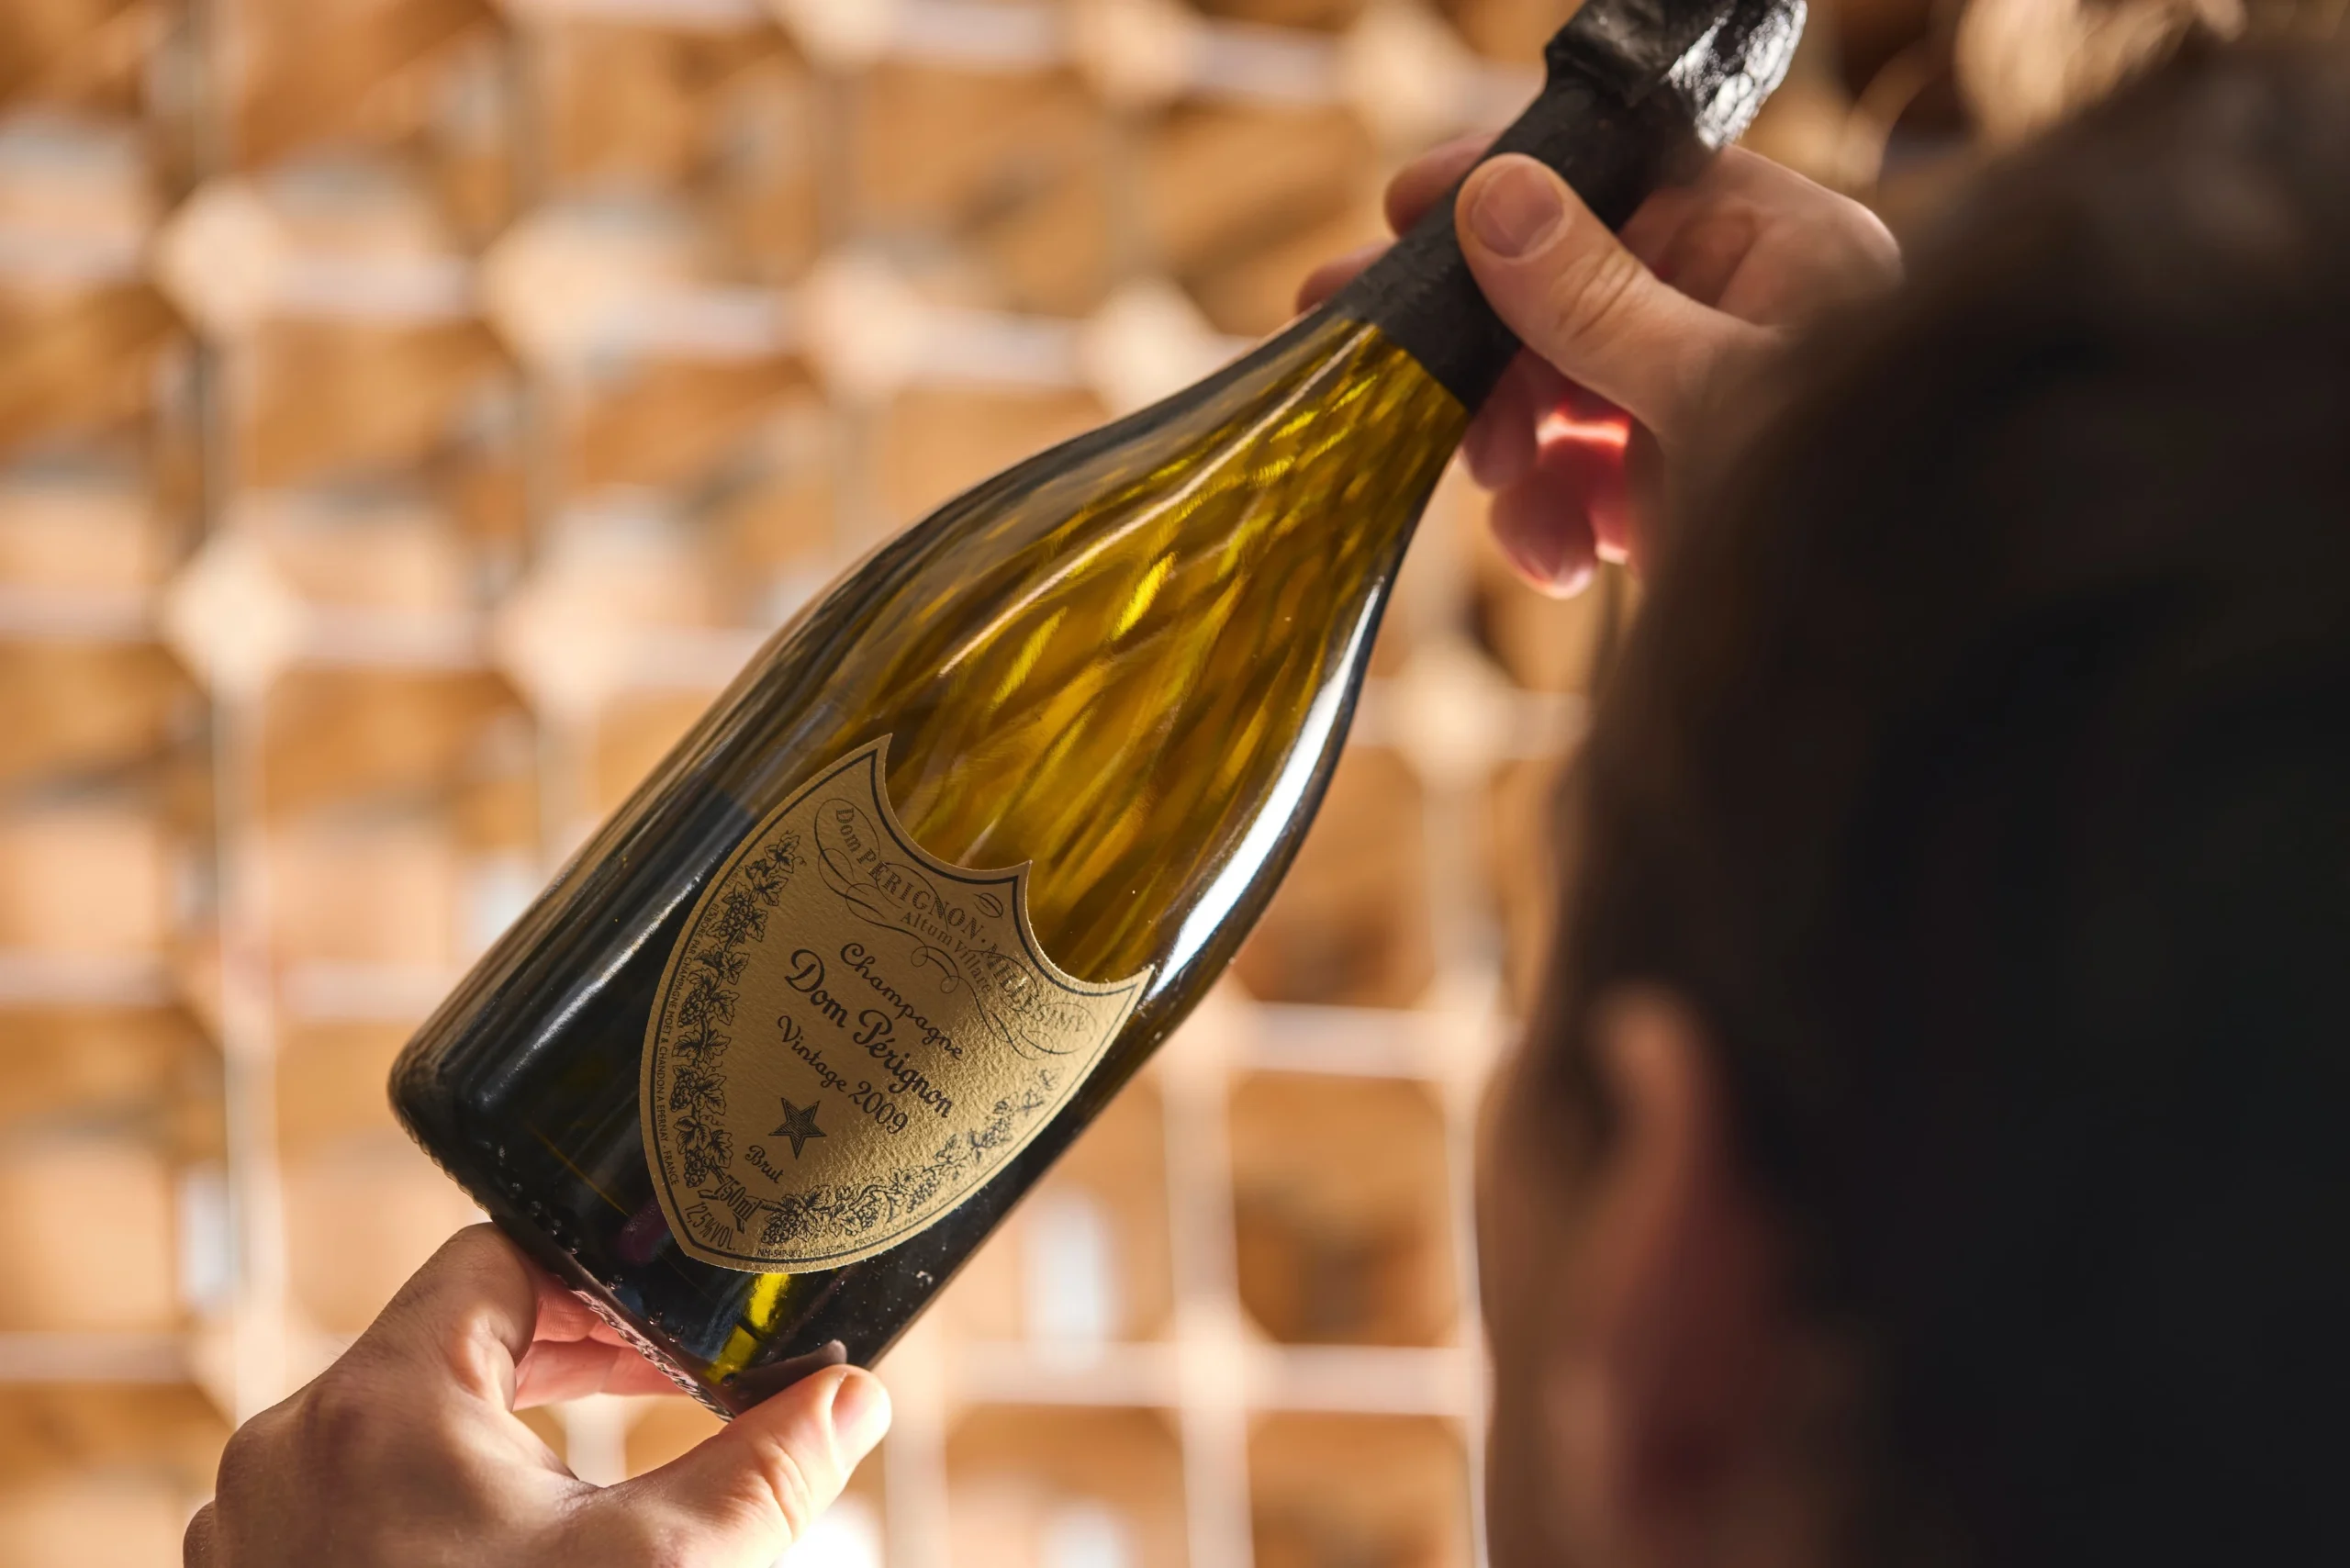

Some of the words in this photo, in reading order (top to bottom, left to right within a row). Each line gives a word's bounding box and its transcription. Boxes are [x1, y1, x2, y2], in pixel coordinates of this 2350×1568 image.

[835, 808, 862, 853] Dom
[688, 938, 700, 954] PAR
[900, 912, 953, 947] Altum
[955, 937, 992, 994] Villare
[669, 957, 692, 1009] CHAMPAGNE
[840, 942, 963, 1060] Champagne
[661, 1010, 676, 1036] MOET
[784, 948, 848, 1028] Dom
[853, 1009, 953, 1118] Pérignon
[656, 1047, 667, 1093] CHANDON
[778, 1014, 847, 1092] Vintage
[848, 1081, 908, 1134] 2009
[656, 1104, 668, 1141] EPERNAY
[663, 1150, 679, 1185] FRANCE
[744, 1145, 783, 1183] Brut
